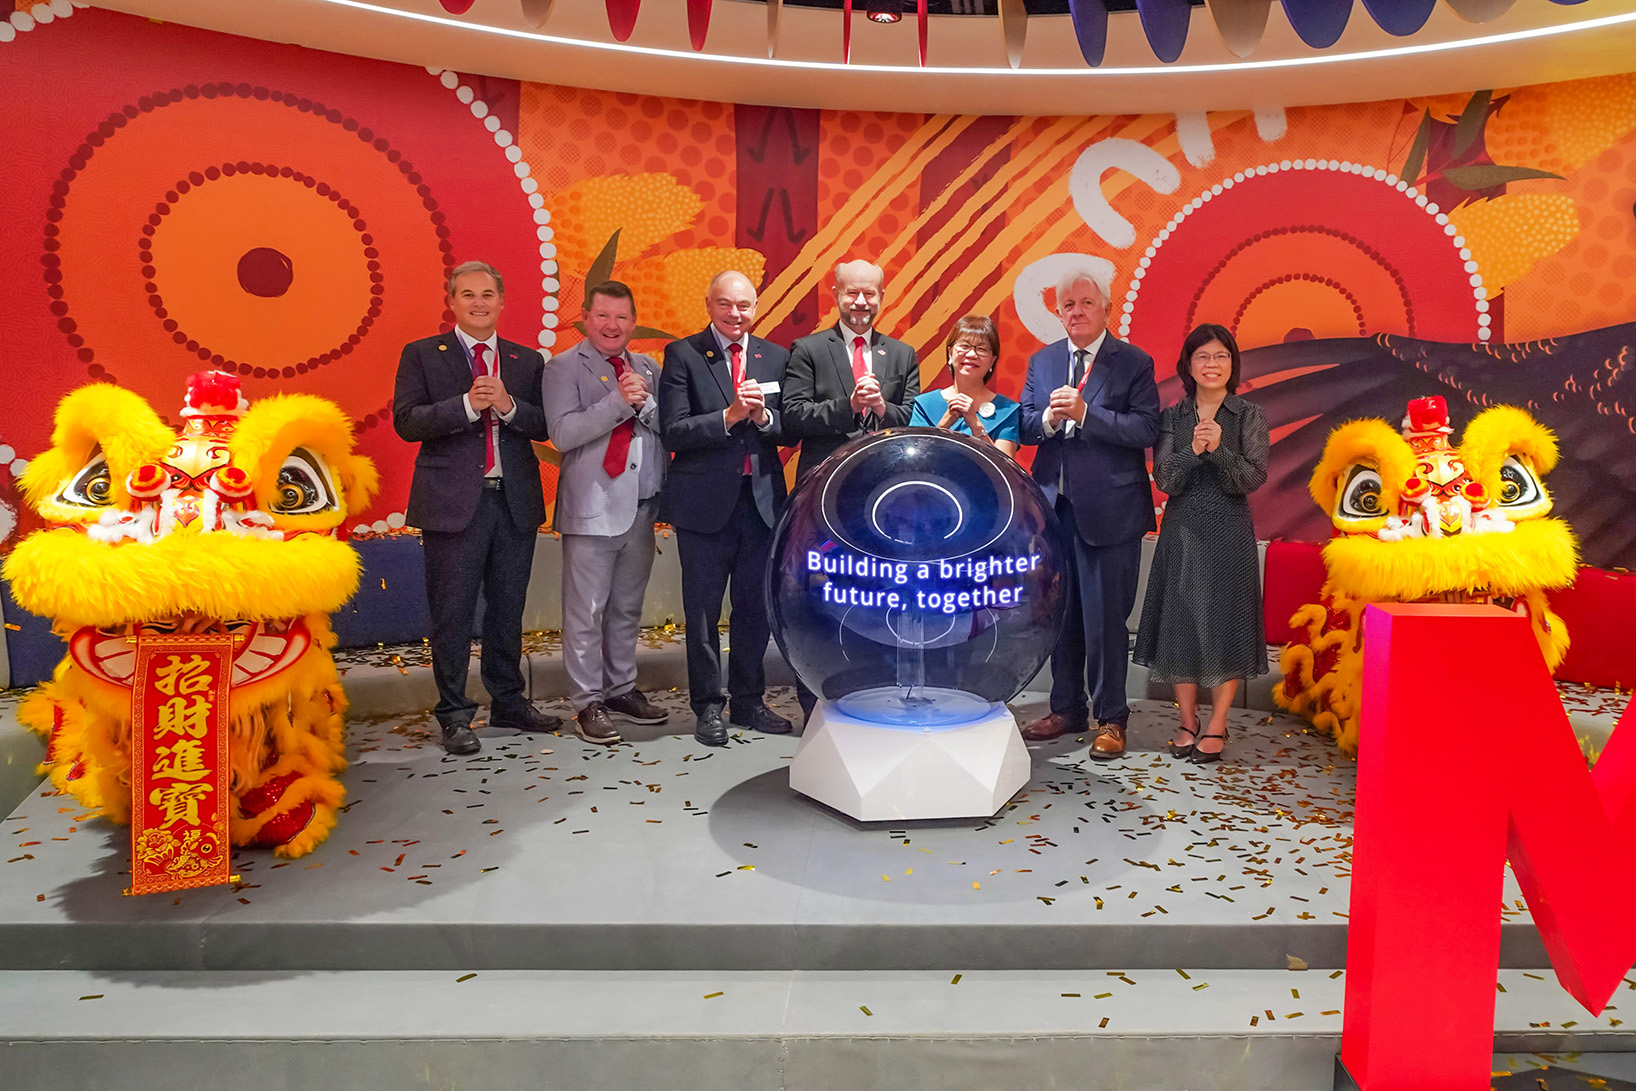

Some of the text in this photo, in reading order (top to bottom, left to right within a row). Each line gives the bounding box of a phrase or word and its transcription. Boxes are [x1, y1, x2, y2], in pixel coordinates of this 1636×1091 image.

[807, 551, 1040, 584] Building a brighter
[823, 582, 1023, 613] future, together
[149, 654, 213, 829] 招財進寶
